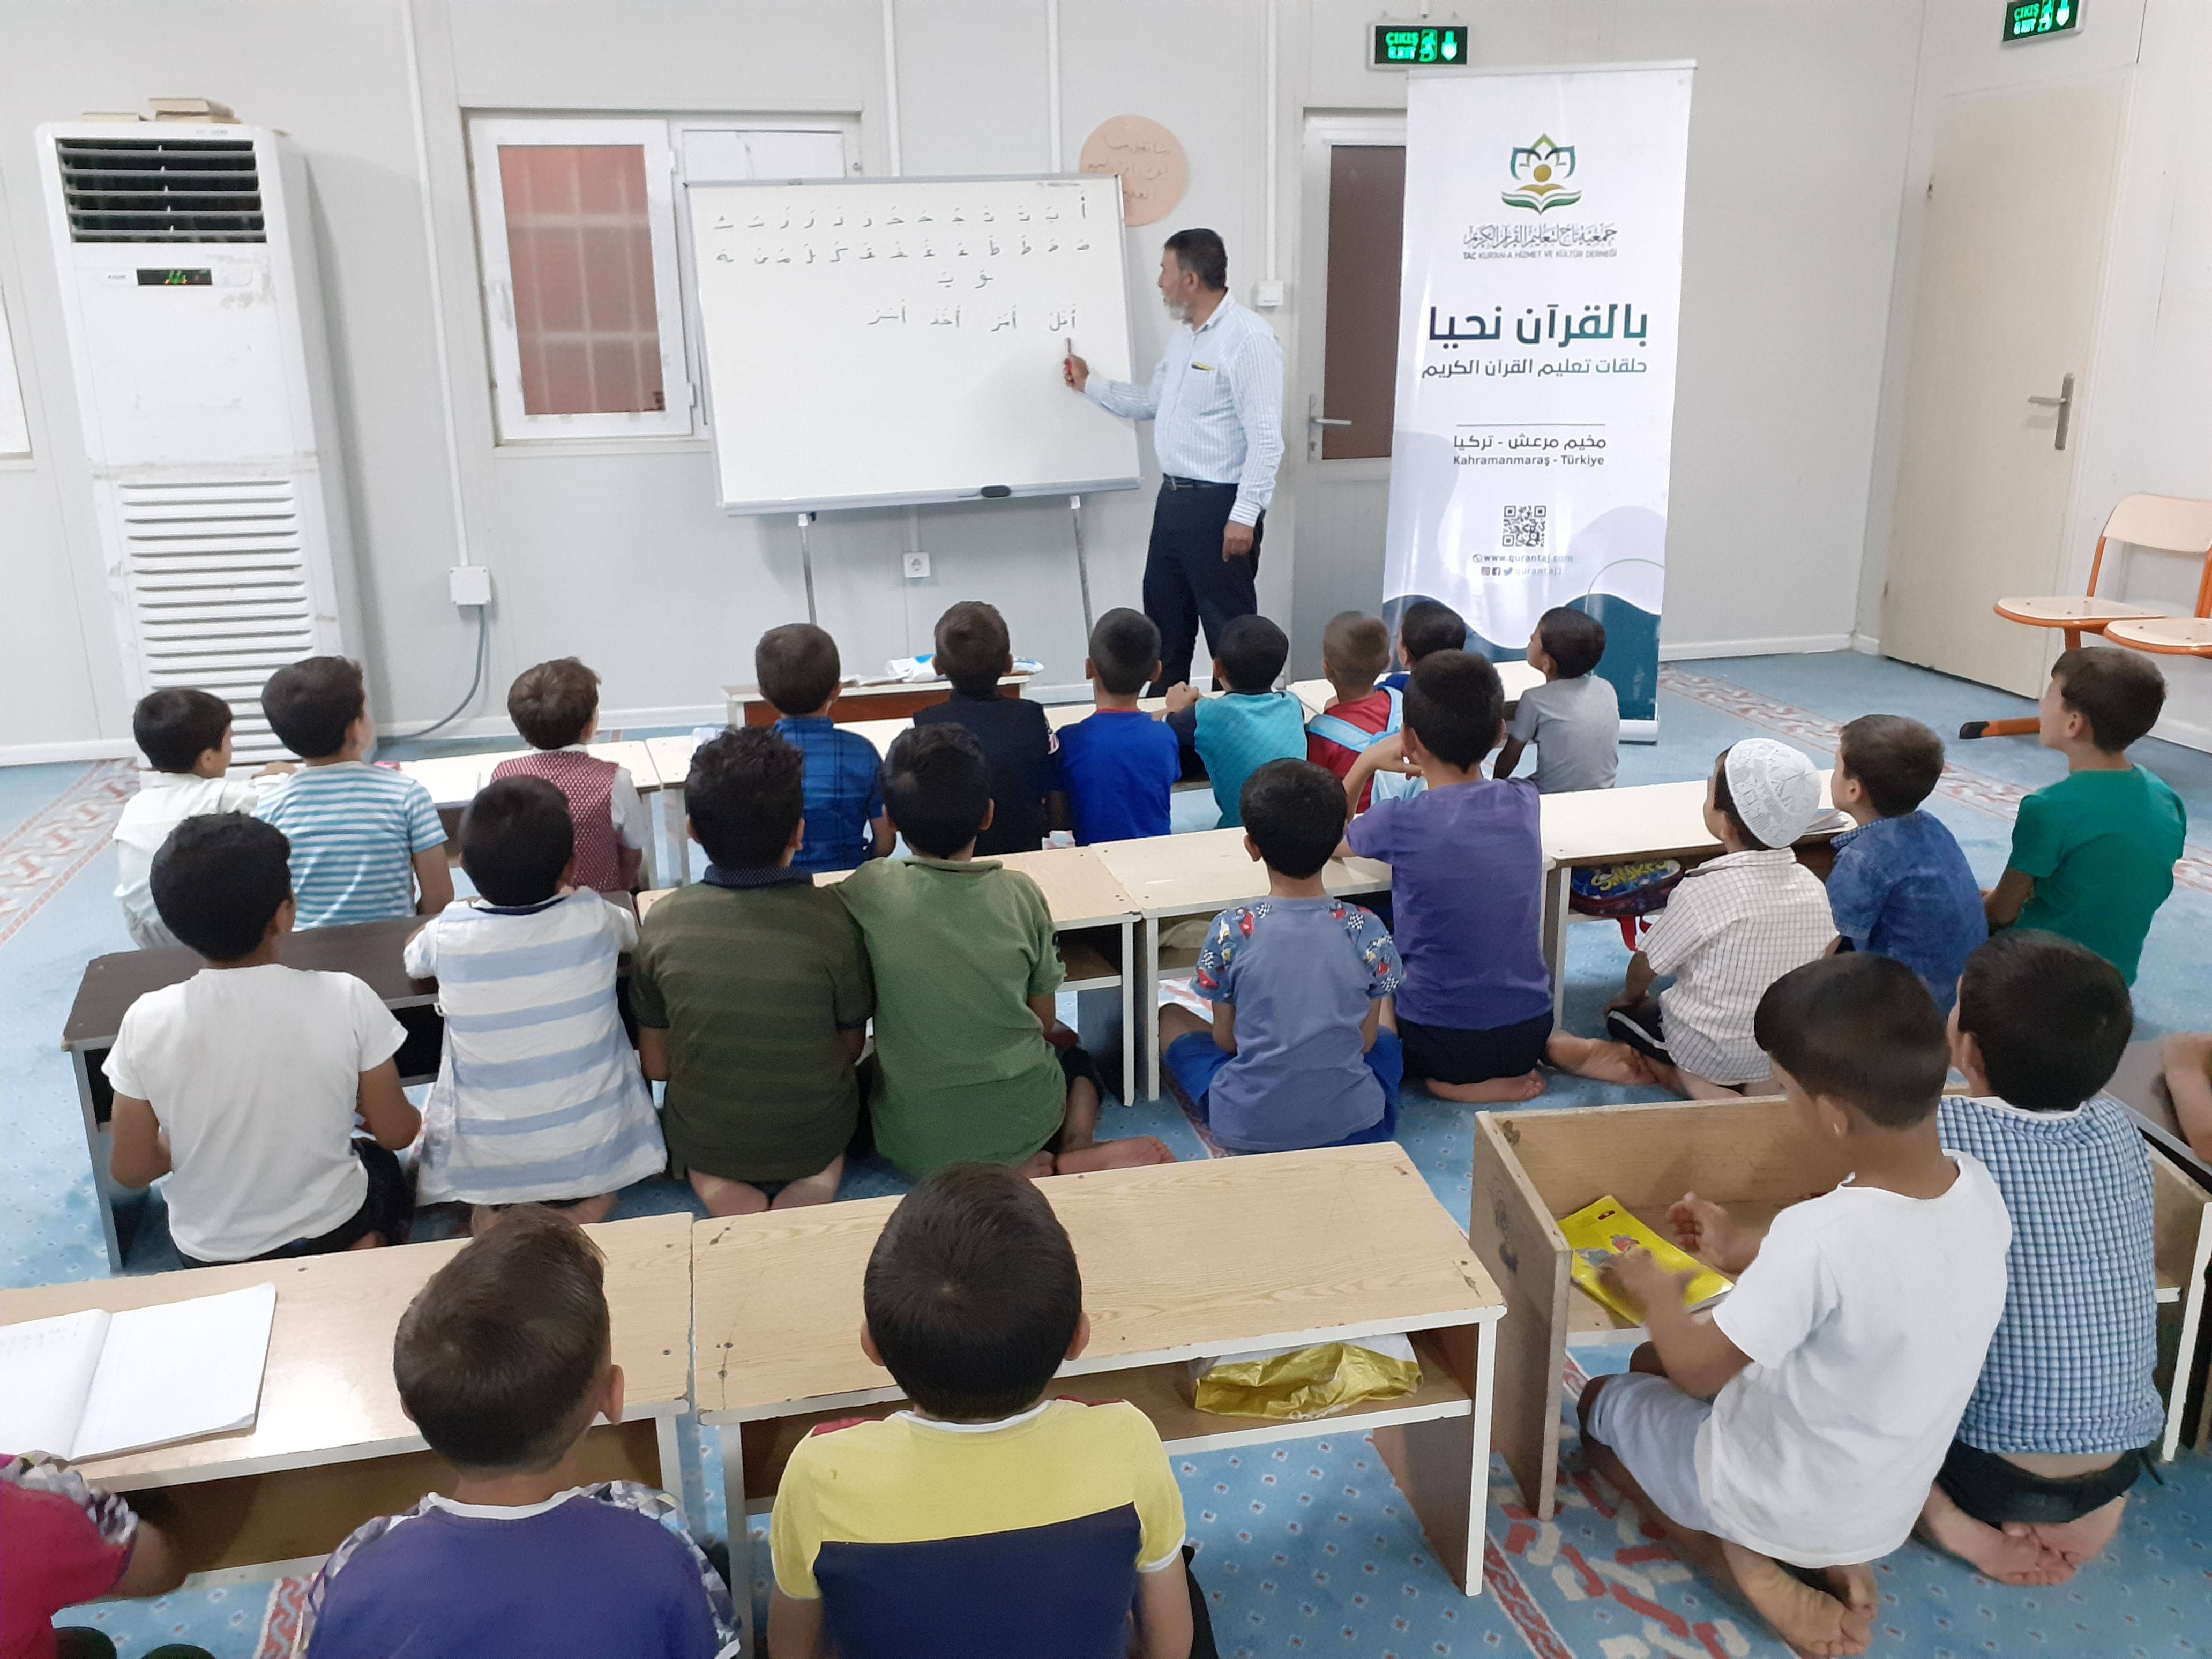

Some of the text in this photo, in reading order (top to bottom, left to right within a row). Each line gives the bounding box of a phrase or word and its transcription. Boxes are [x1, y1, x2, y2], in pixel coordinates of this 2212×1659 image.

[1429, 303, 1647, 349] بالقرآن نحيا
[1422, 360, 1479, 379] الكريم
[1537, 358, 1591, 377] تعليم
[1596, 358, 1647, 373] حلقات
[1454, 435, 1494, 451] تركيا
[1508, 432, 1559, 450] مرعش
[1564, 435, 1606, 451] مخيم
[1453, 455, 1550, 467] Kahramanmaraş
[1560, 454, 1604, 467] Türkiye
[1484, 554, 1573, 563] www.qurantaj.com
[1515, 567, 1563, 576] qurantaj1
